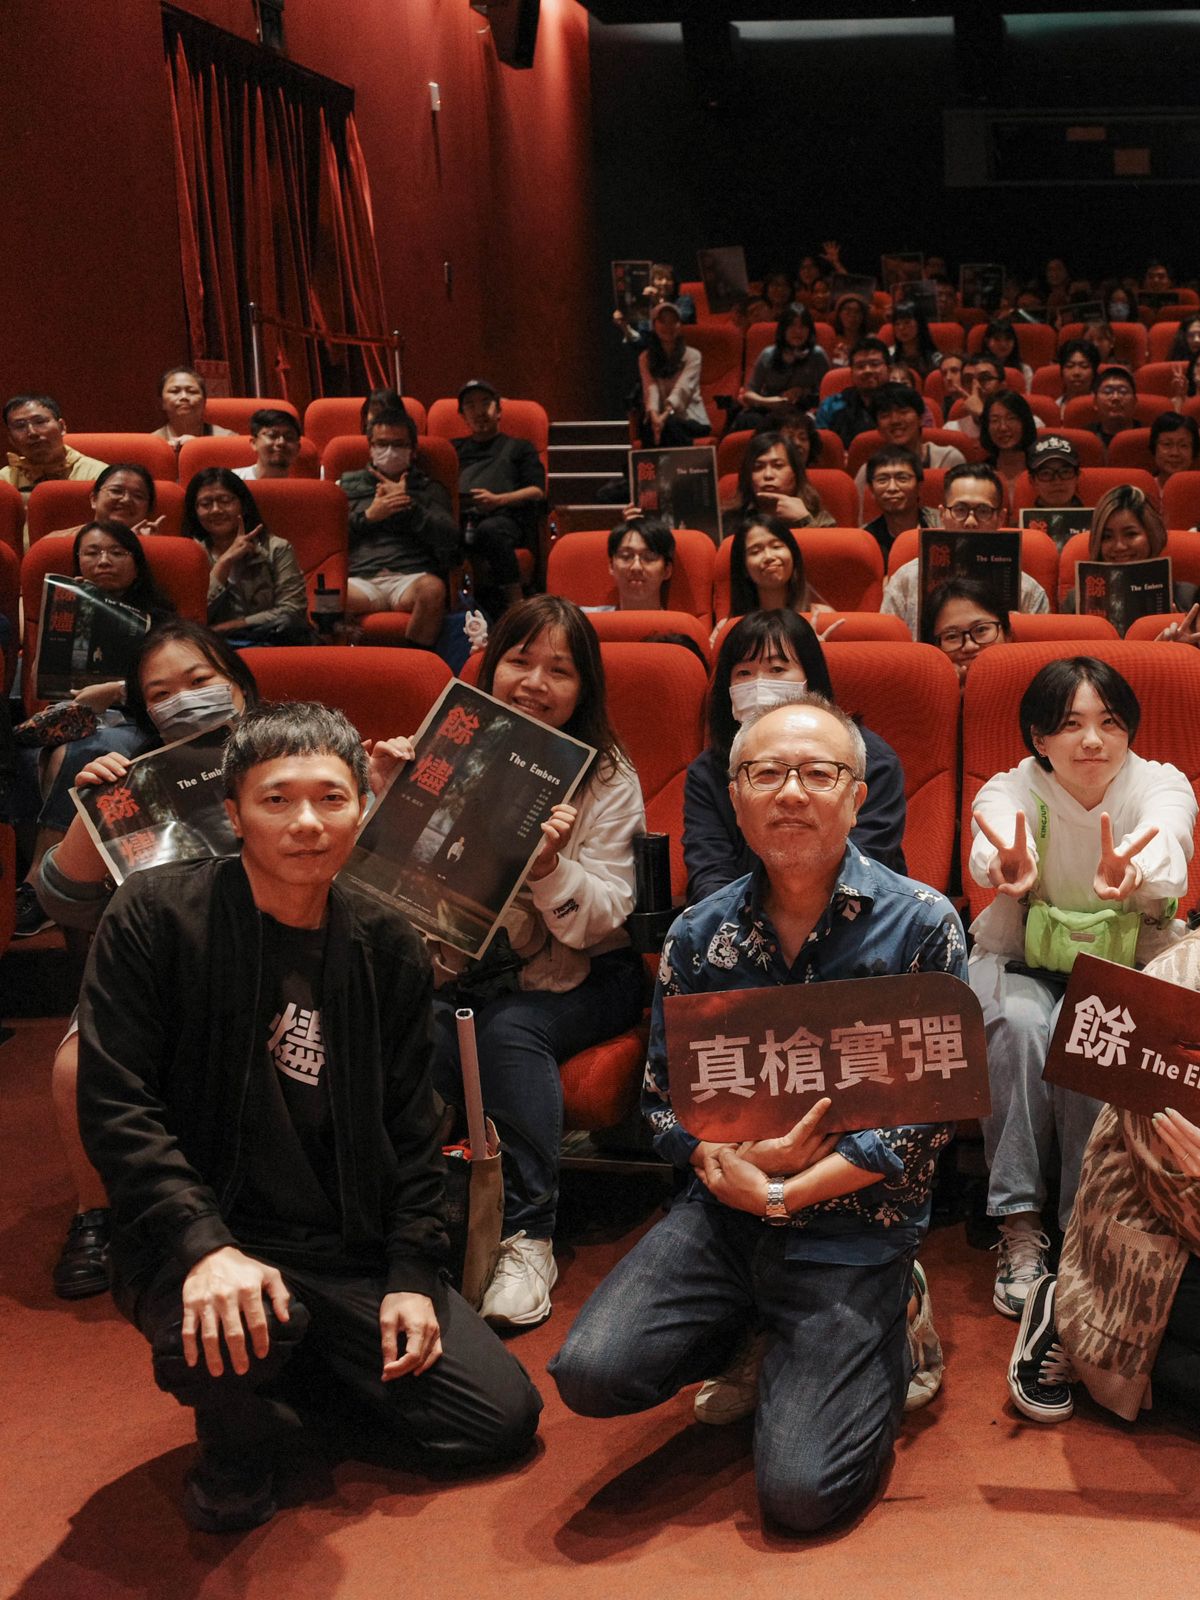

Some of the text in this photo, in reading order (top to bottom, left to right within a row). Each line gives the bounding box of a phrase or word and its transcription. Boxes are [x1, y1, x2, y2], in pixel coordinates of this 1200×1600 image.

[177, 768, 224, 791] The Emb
[509, 752, 561, 786] The Embers
[1065, 994, 1137, 1067] 餘
[689, 1013, 969, 1104] 真槍實彈
[1141, 1047, 1180, 1081] The
